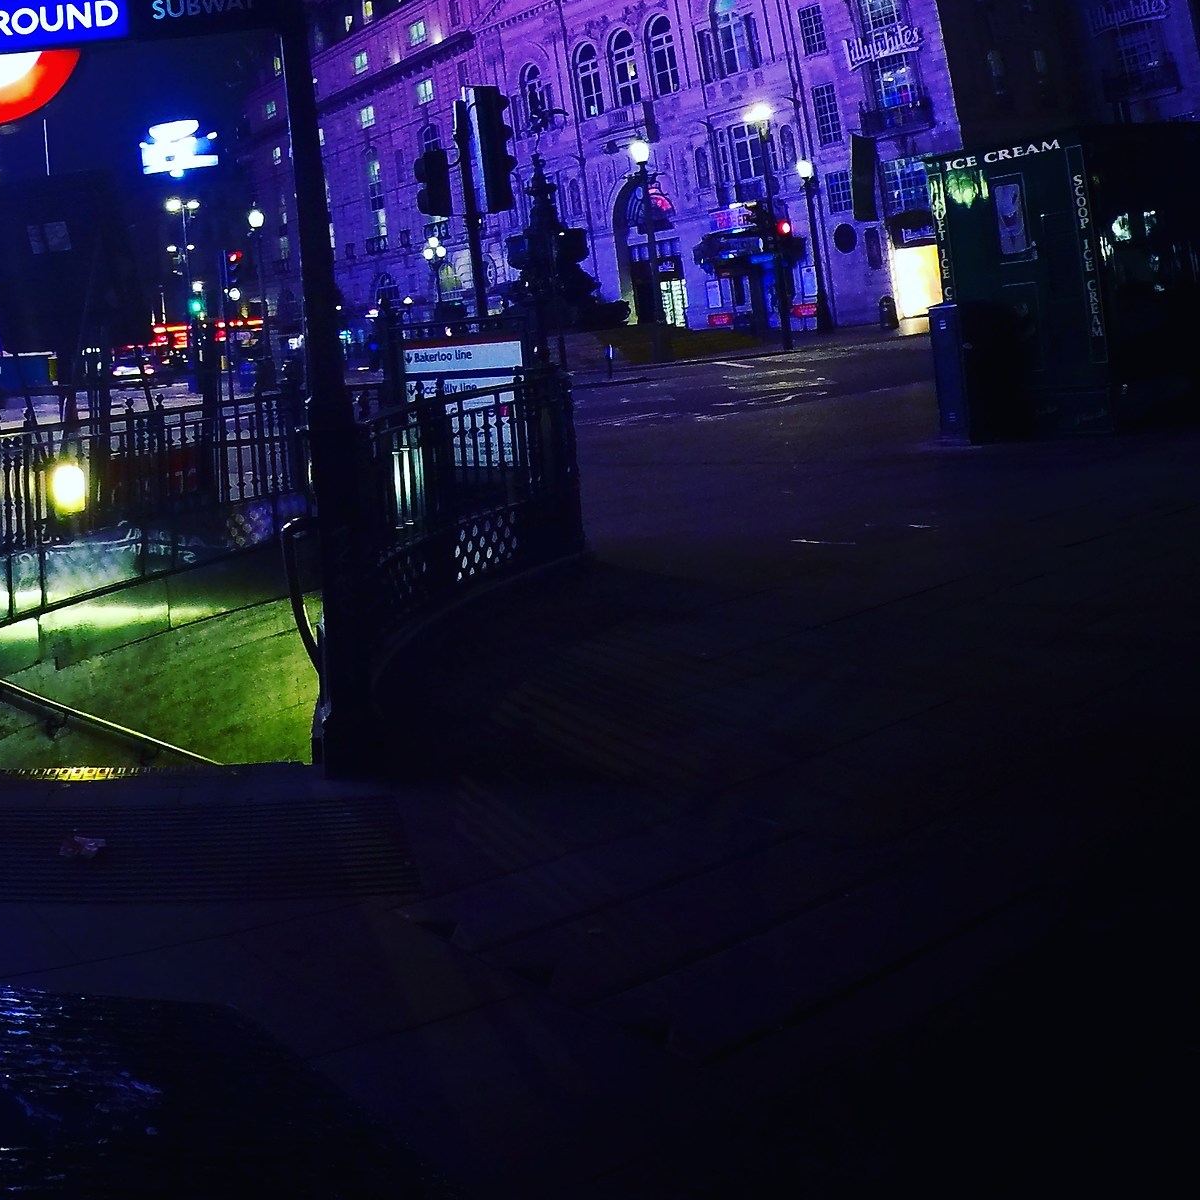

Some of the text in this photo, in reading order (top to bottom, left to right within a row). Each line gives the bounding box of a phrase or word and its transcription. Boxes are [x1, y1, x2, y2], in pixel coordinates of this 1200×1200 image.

[944, 138, 1061, 173] ICE CREAM
[1072, 174, 1104, 338] SCOOP ICE CREAM
[414, 350, 473, 363] Bakerloo line
